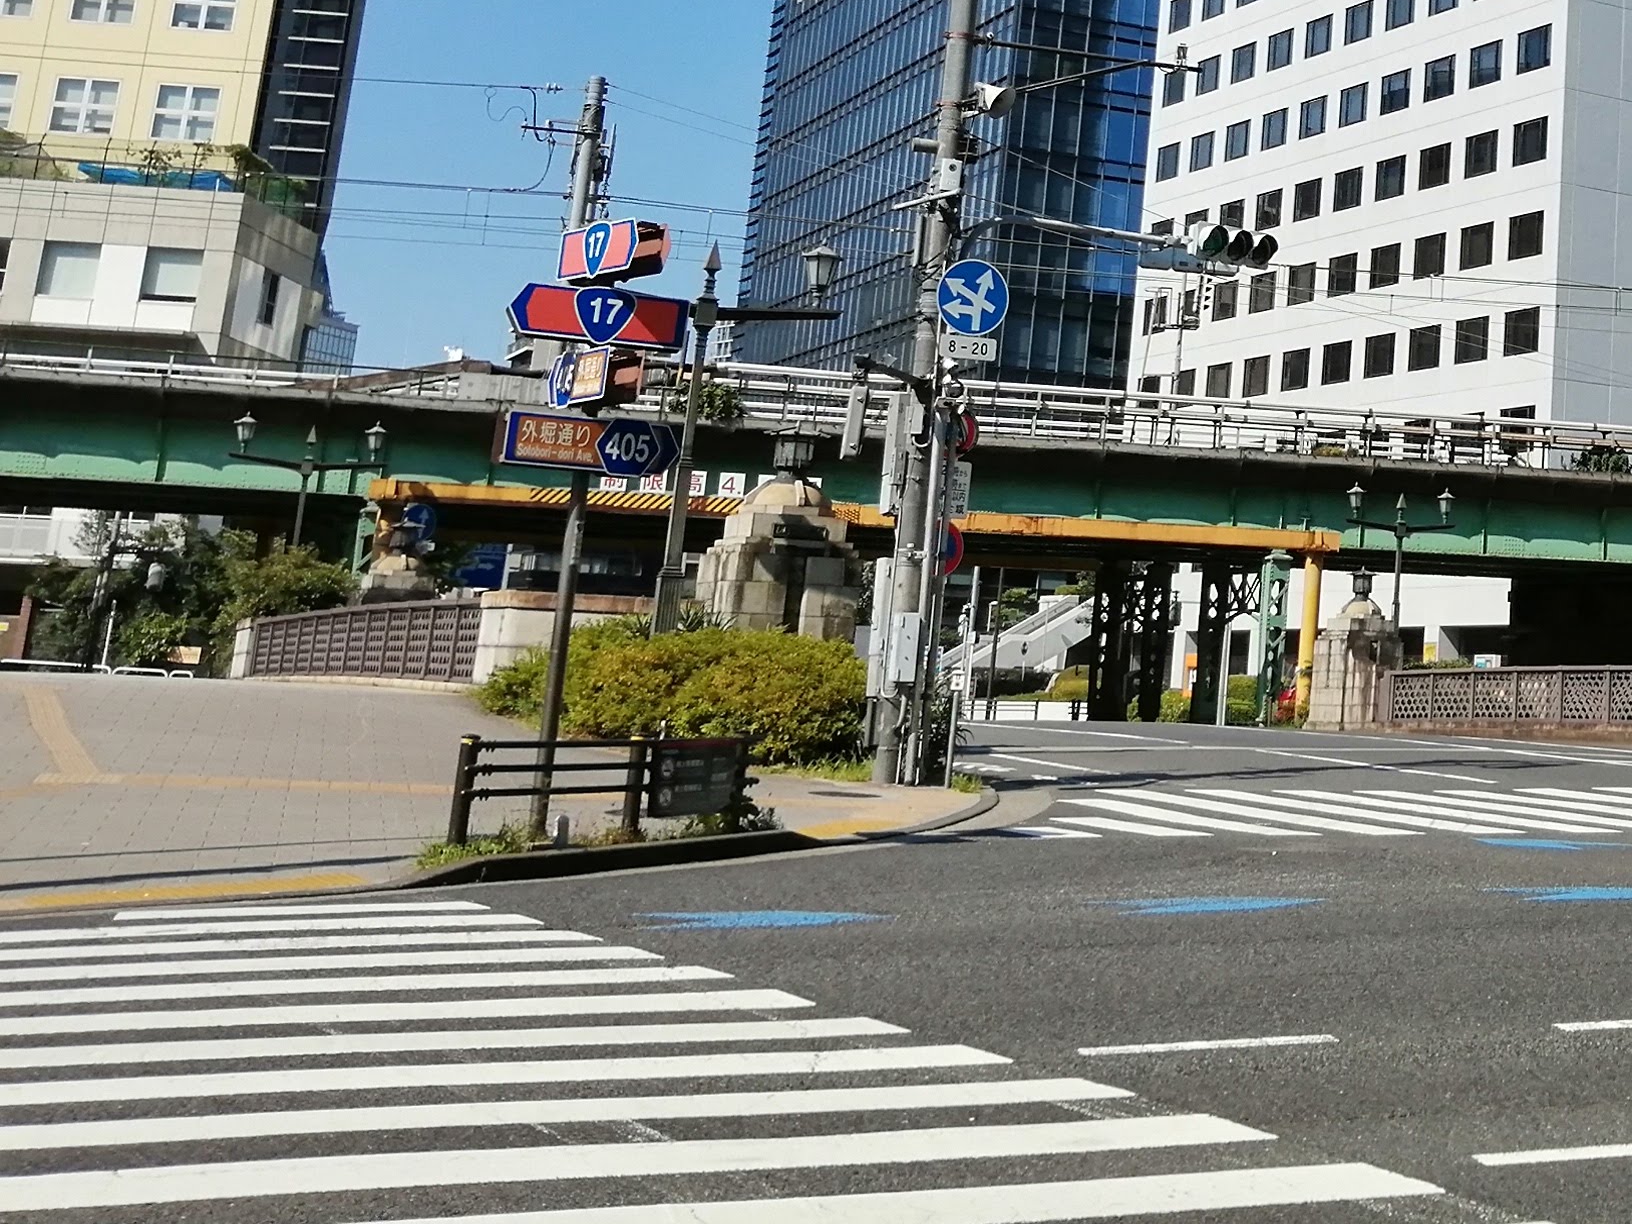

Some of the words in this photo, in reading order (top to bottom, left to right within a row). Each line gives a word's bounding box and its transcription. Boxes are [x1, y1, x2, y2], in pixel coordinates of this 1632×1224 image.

[588, 230, 606, 259] 17
[590, 297, 624, 325] 17
[521, 419, 591, 447] 外堀通り
[576, 449, 594, 463] Ave.
[605, 432, 651, 463] 405
